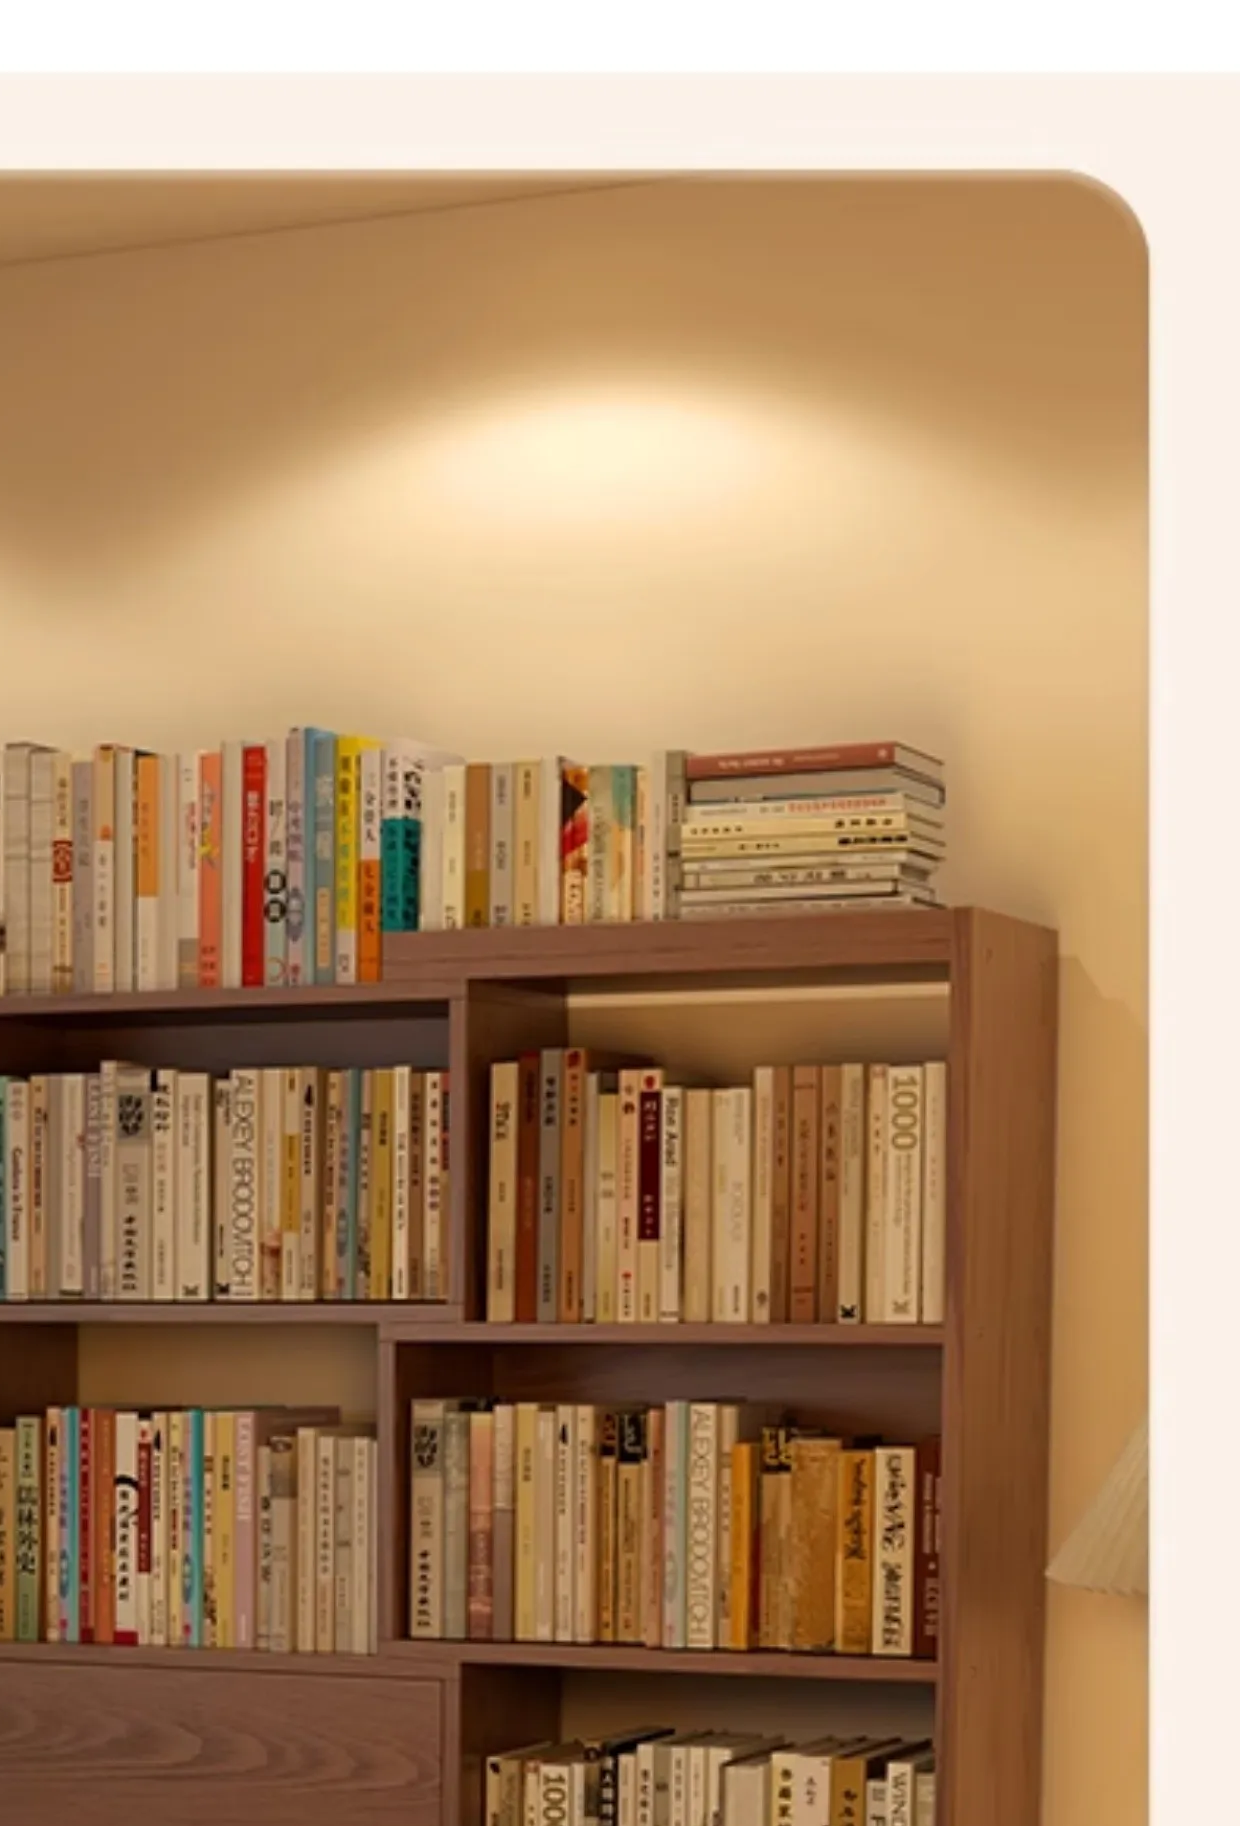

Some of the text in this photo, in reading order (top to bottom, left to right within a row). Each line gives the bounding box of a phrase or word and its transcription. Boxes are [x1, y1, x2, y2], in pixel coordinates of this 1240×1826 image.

[232, 1076, 254, 1152] ALEXEY
[891, 1075, 918, 1150] 1000
[691, 1409, 711, 1493] ALEXEY
